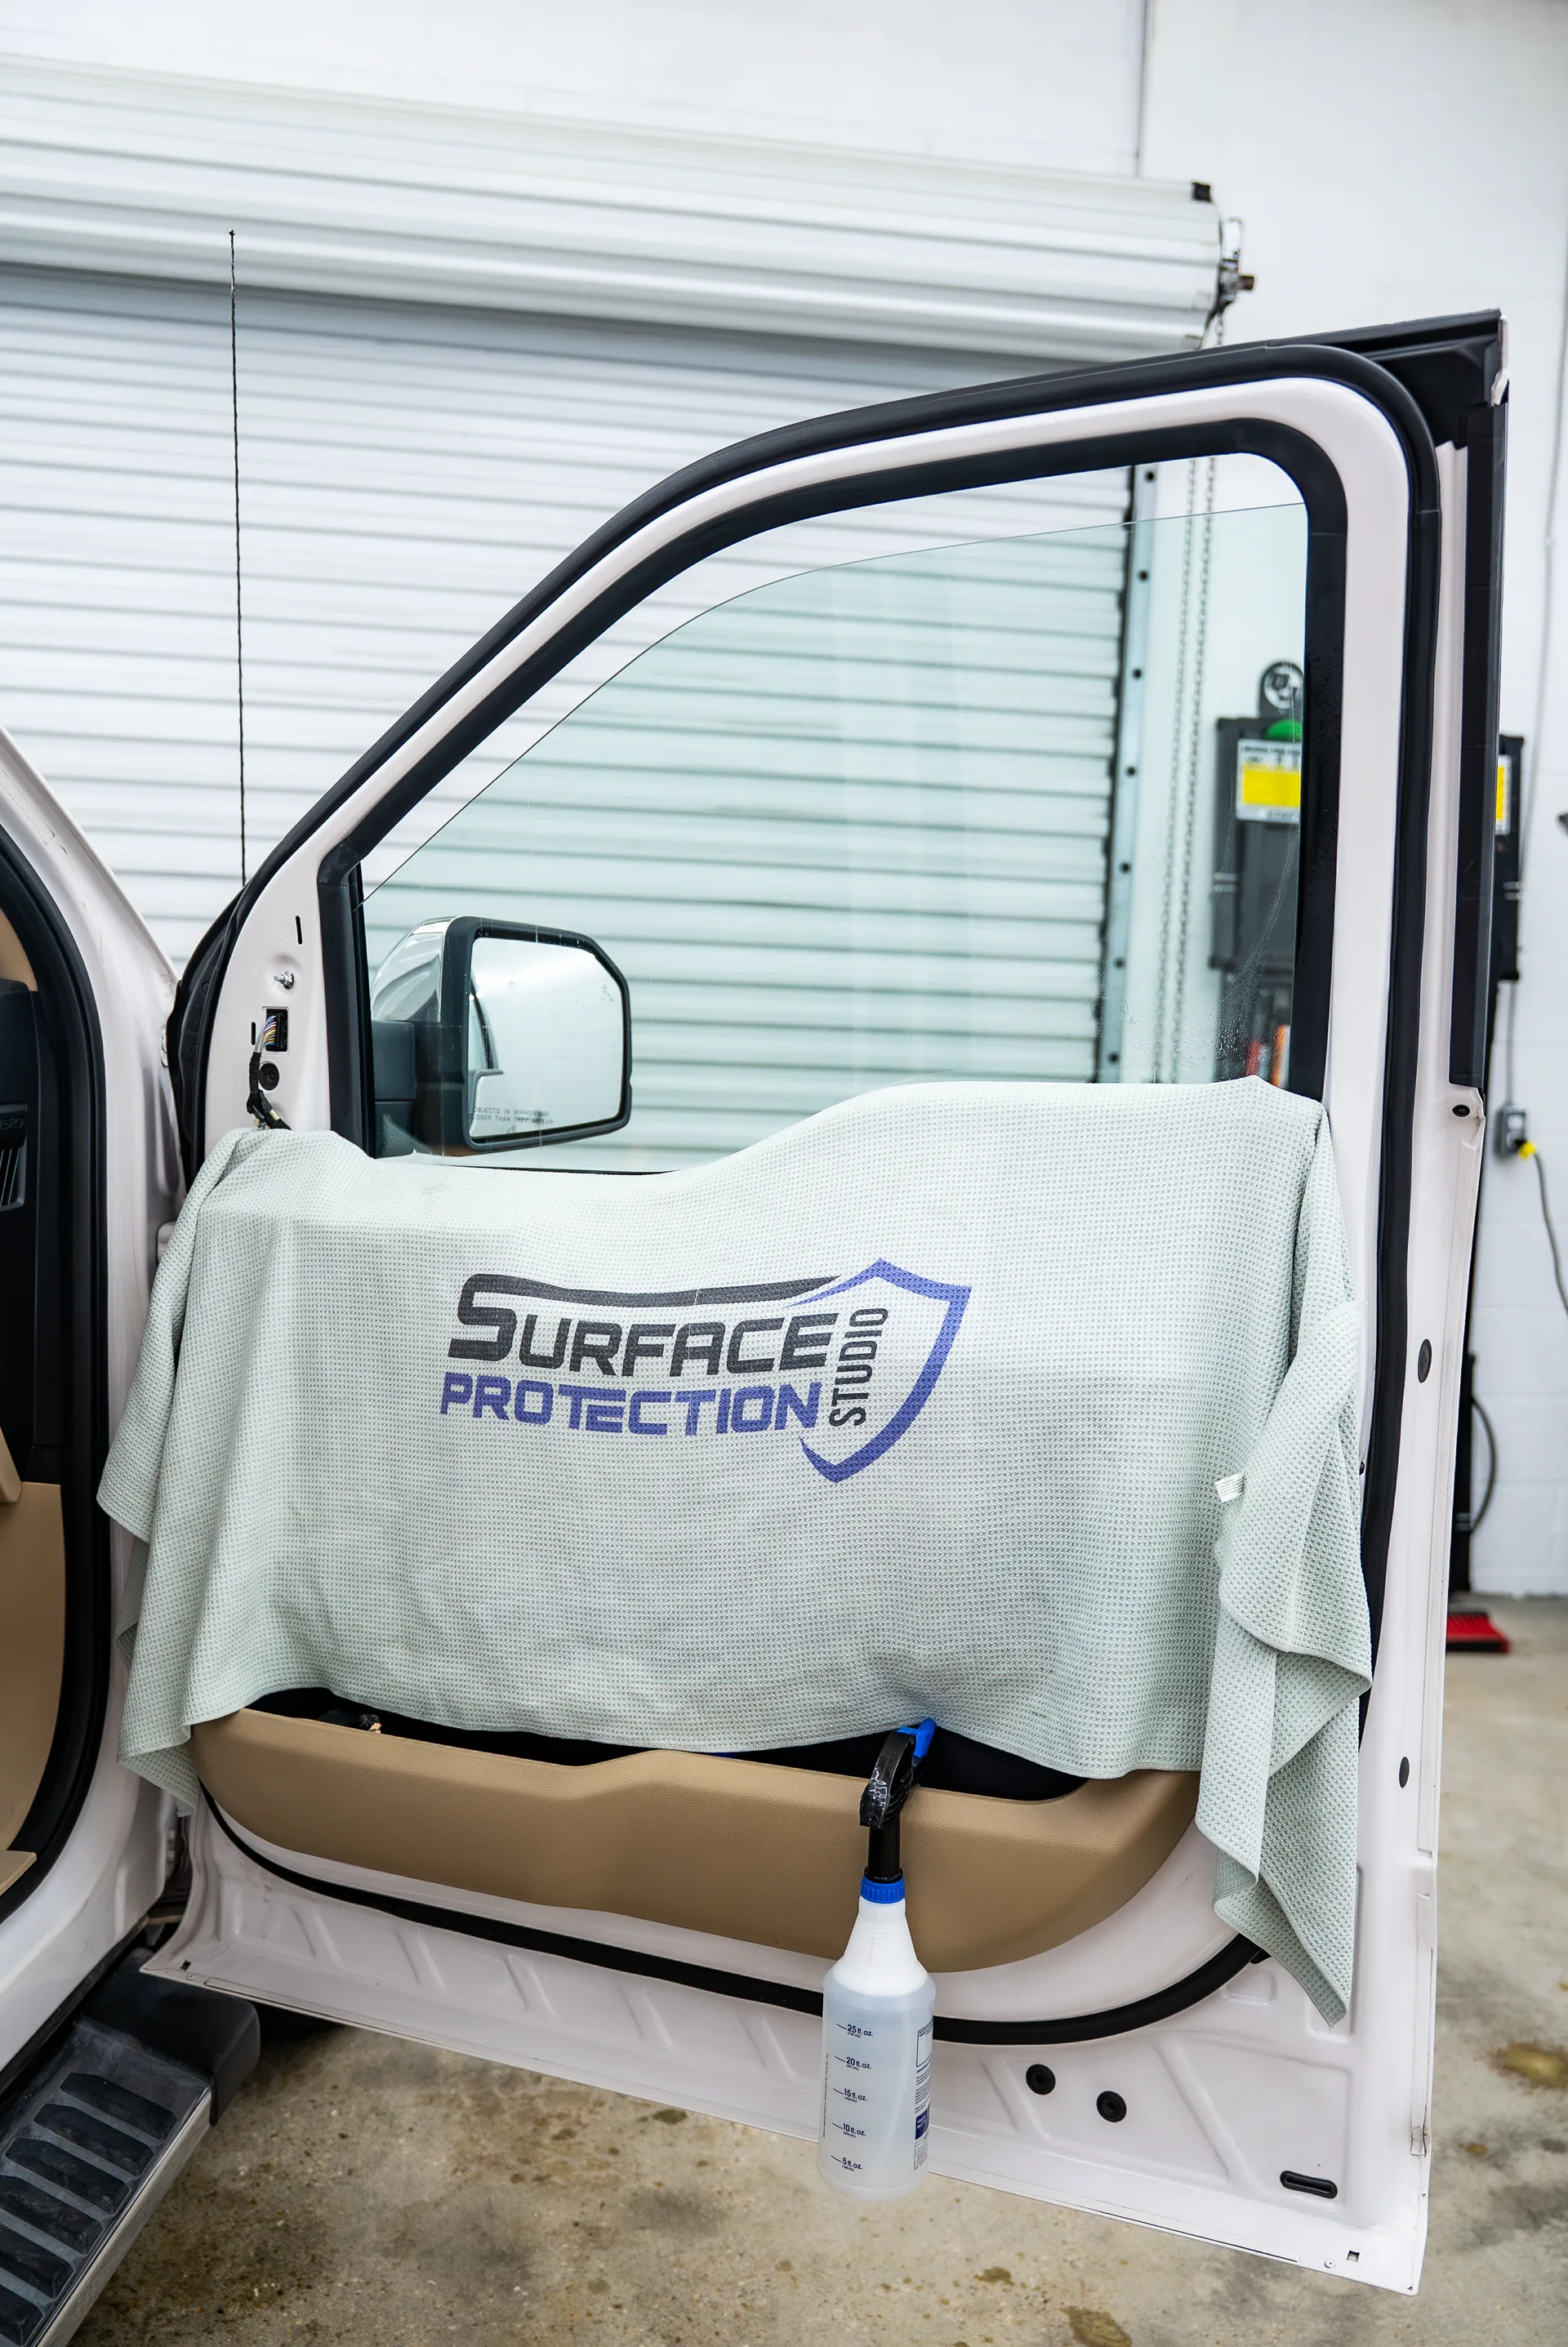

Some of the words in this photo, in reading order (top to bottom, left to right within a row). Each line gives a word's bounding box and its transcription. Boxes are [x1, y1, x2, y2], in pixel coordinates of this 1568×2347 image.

[474, 1107, 501, 1115] OBJECTS
[514, 1116, 529, 1125] THEY
[448, 1273, 841, 1377] SURFACE
[828, 1307, 889, 1427] STUDIO
[440, 1370, 822, 1436] PROTECTION
[847, 2024, 857, 2033] 25
[846, 2056, 855, 2066] 20
[844, 2087, 852, 2097] 15
[843, 2122, 850, 2132] 10
[842, 2157, 847, 2165] 5
